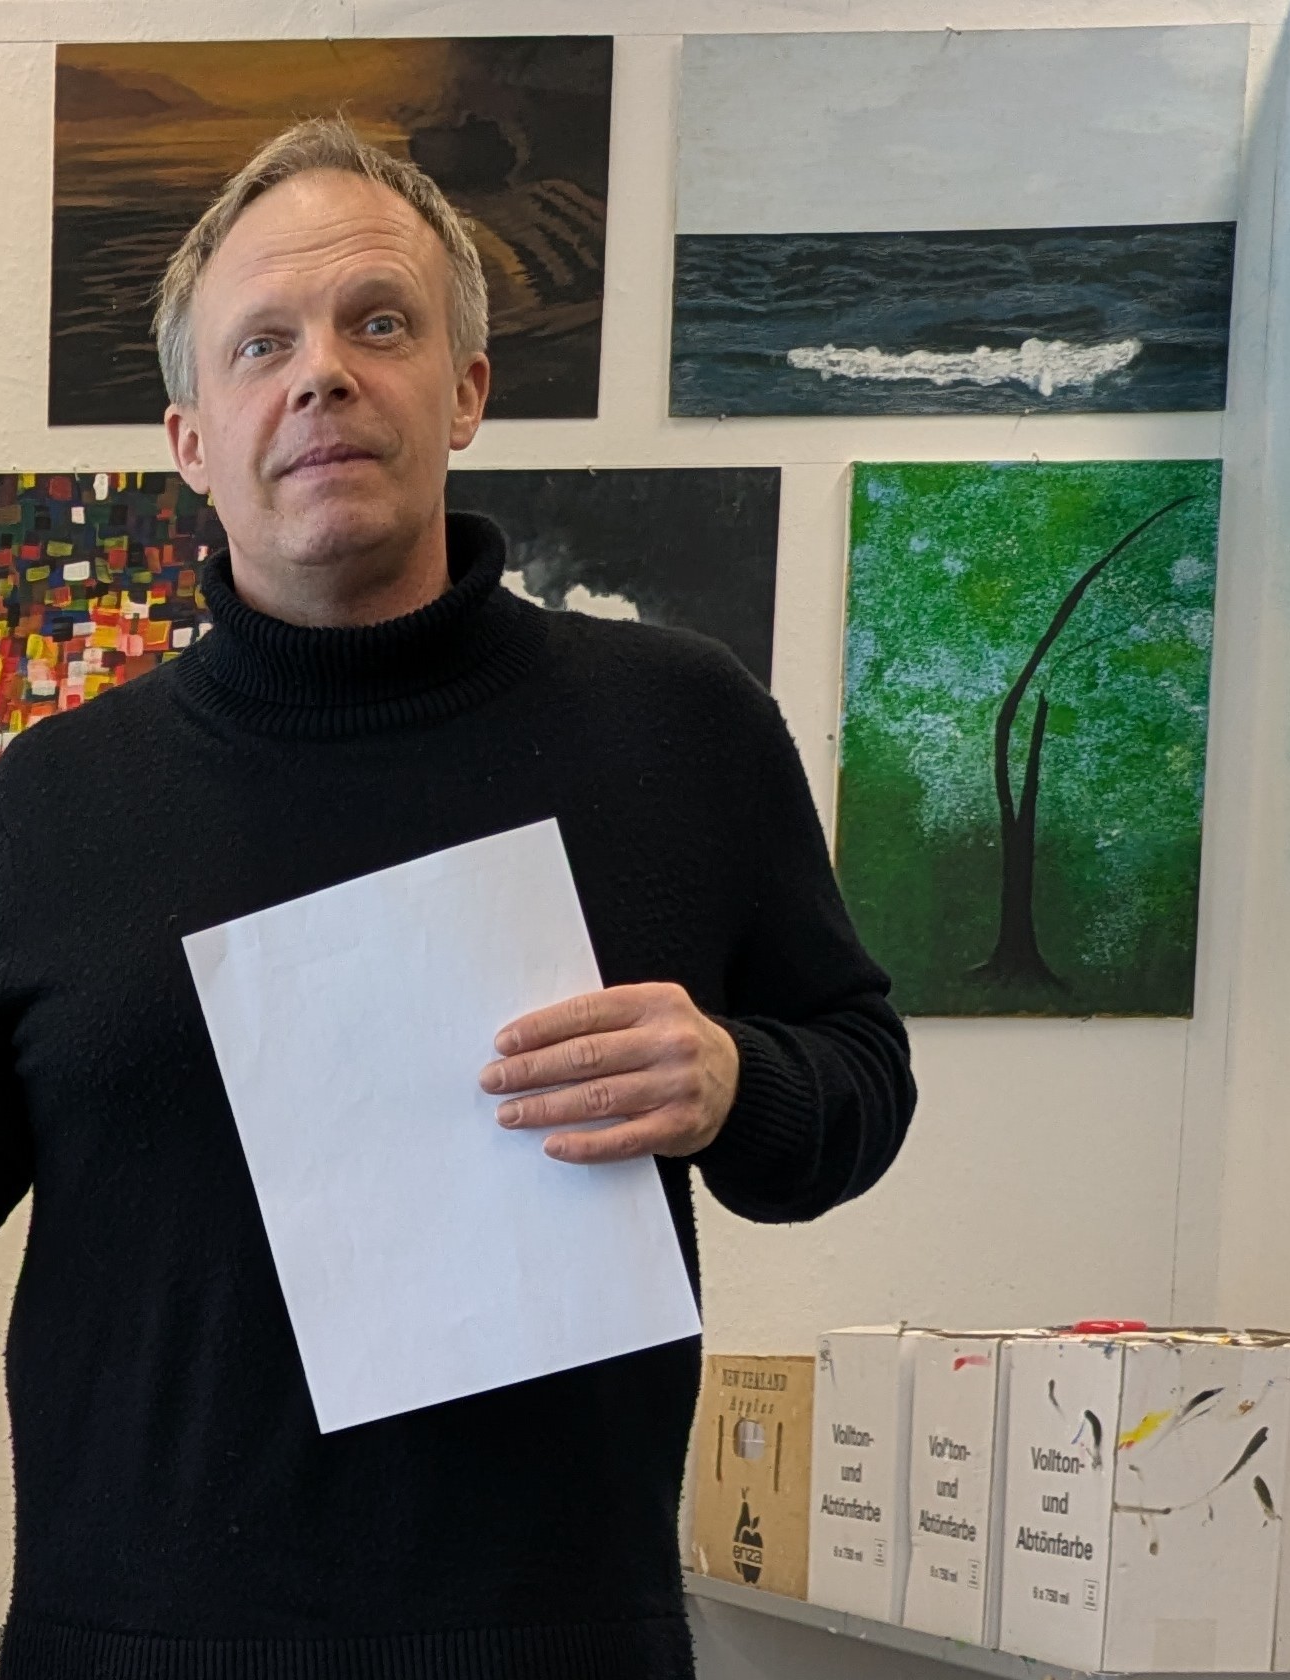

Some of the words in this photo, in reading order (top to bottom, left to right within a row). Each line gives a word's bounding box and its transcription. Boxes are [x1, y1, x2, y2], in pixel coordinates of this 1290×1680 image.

[831, 1423, 875, 1447] Vollton-
[928, 1434, 971, 1462] Vollton-
[840, 1462, 862, 1483] und
[1030, 1446, 1085, 1475] Vollton-
[936, 1477, 959, 1499] und
[820, 1493, 882, 1523] Abtönfarbe
[1041, 1491, 1070, 1515] und
[918, 1509, 977, 1542] Abtönfarbe
[1015, 1526, 1093, 1561] Abtönfarbe
